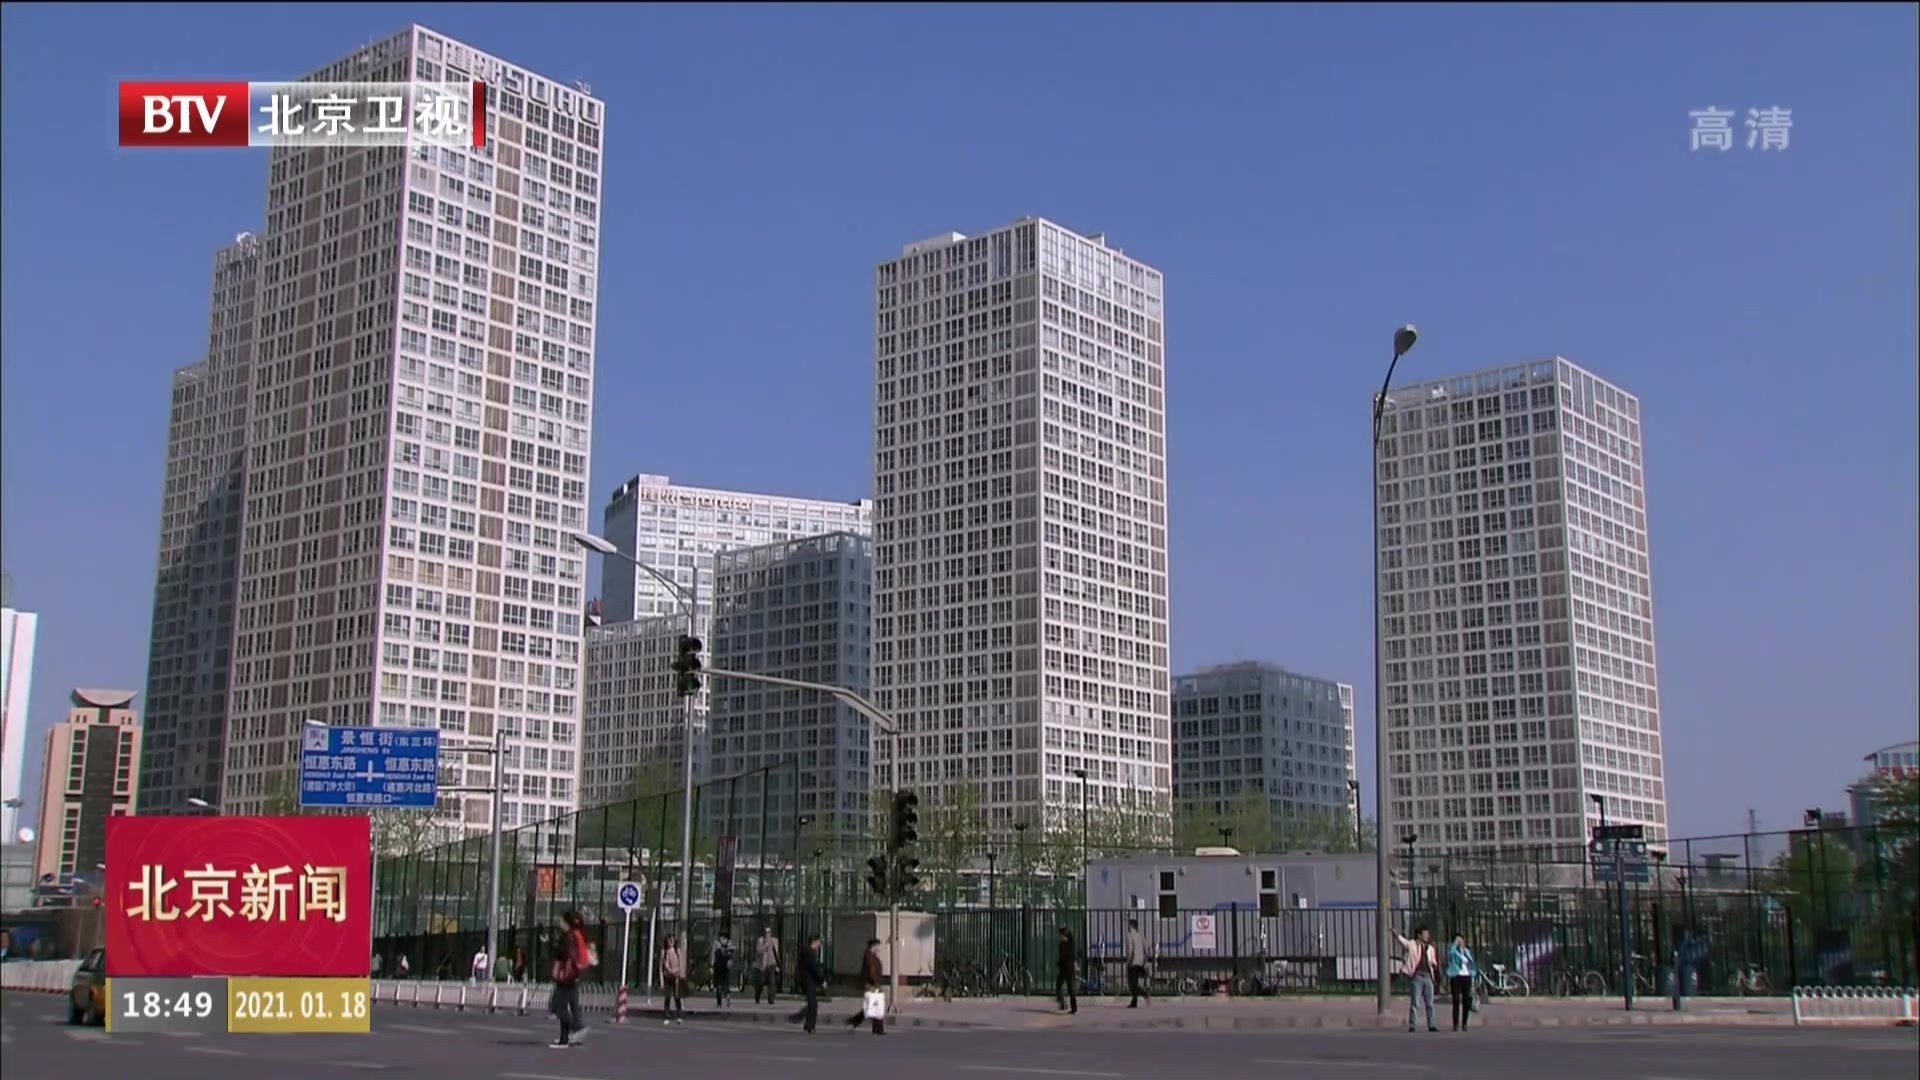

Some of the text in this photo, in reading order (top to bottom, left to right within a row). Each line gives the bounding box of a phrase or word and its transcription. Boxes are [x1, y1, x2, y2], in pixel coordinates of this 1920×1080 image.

[341, 730, 394, 747] 景恒街
[304, 755, 356, 770] 恒惠东路
[384, 757, 435, 772] 恒惠东路
